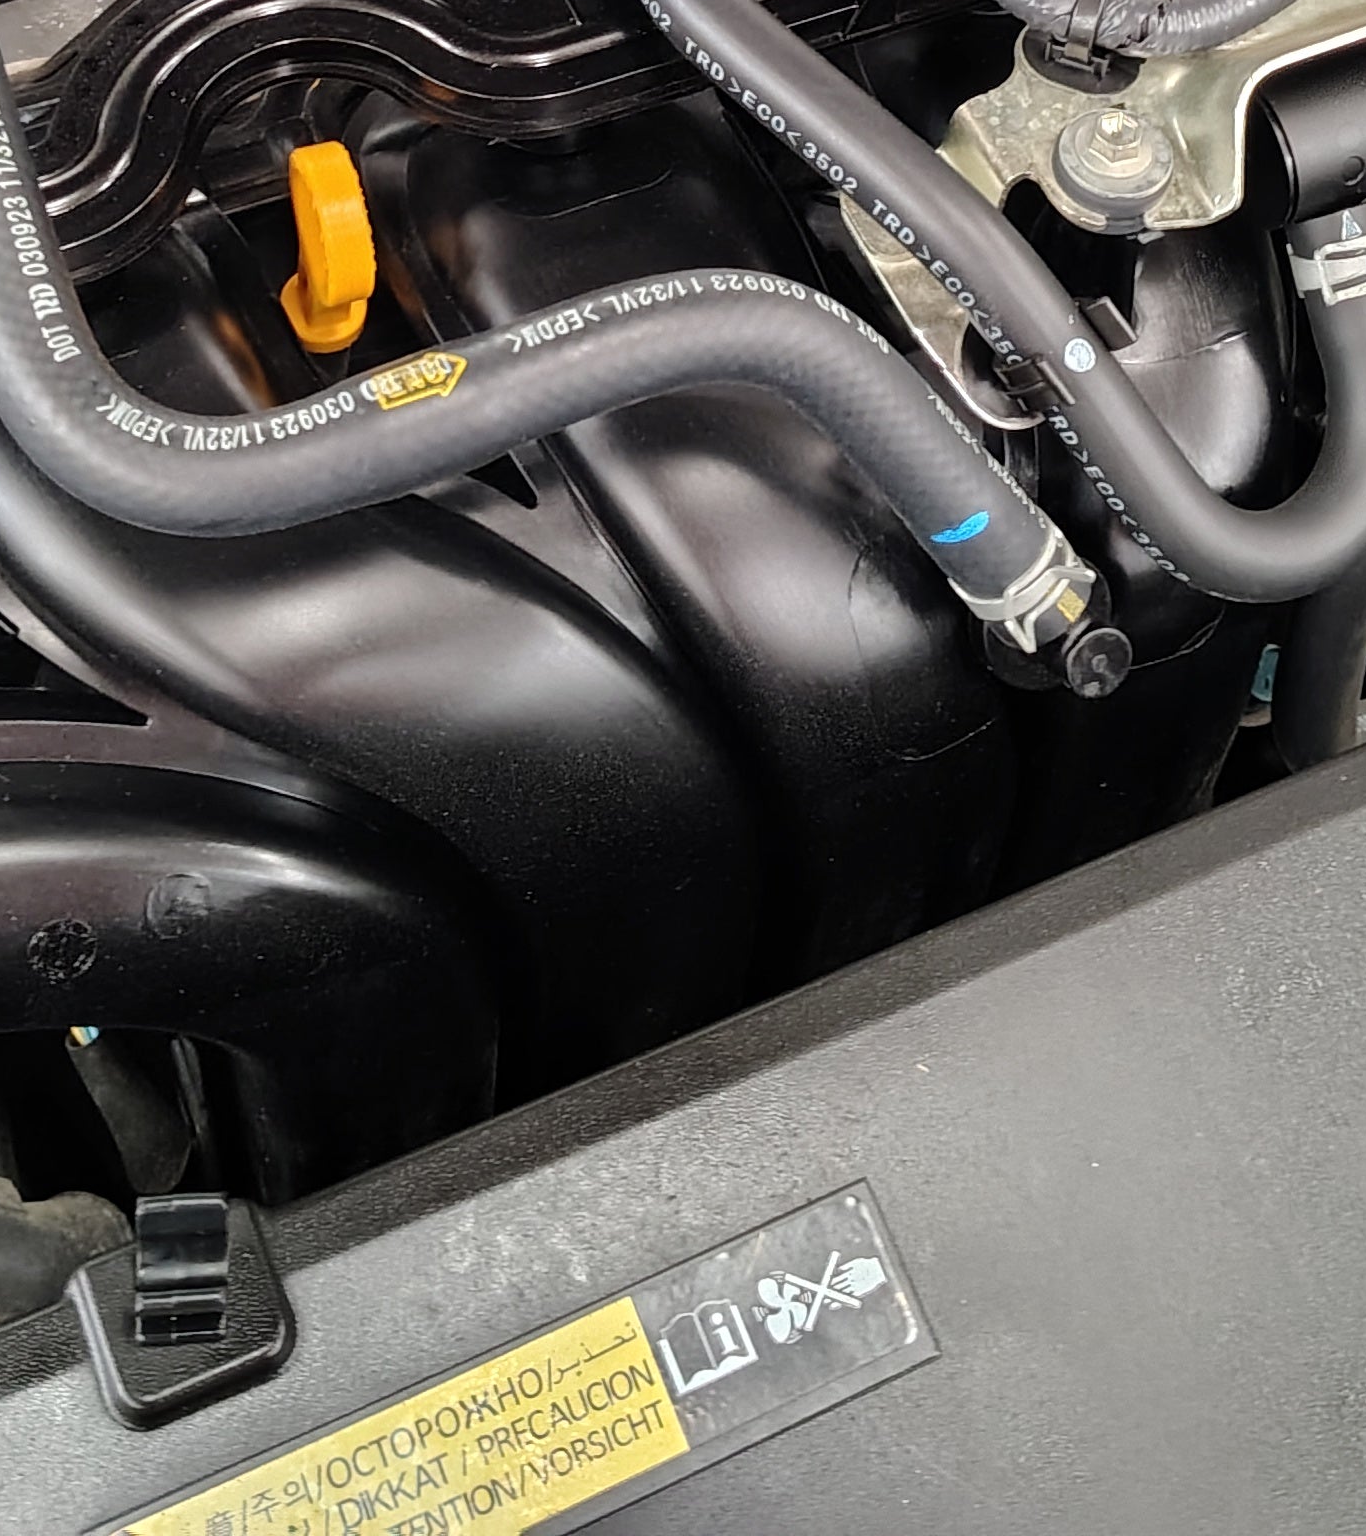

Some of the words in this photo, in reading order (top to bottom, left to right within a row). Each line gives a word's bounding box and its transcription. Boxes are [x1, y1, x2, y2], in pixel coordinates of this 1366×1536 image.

[2, 196, 50, 278] 030923
[710, 273, 807, 301] 030923
[40, 325, 83, 364] DOT
[272, 390, 356, 440] 030923
[476, 1358, 655, 1466] PRECAUCION
